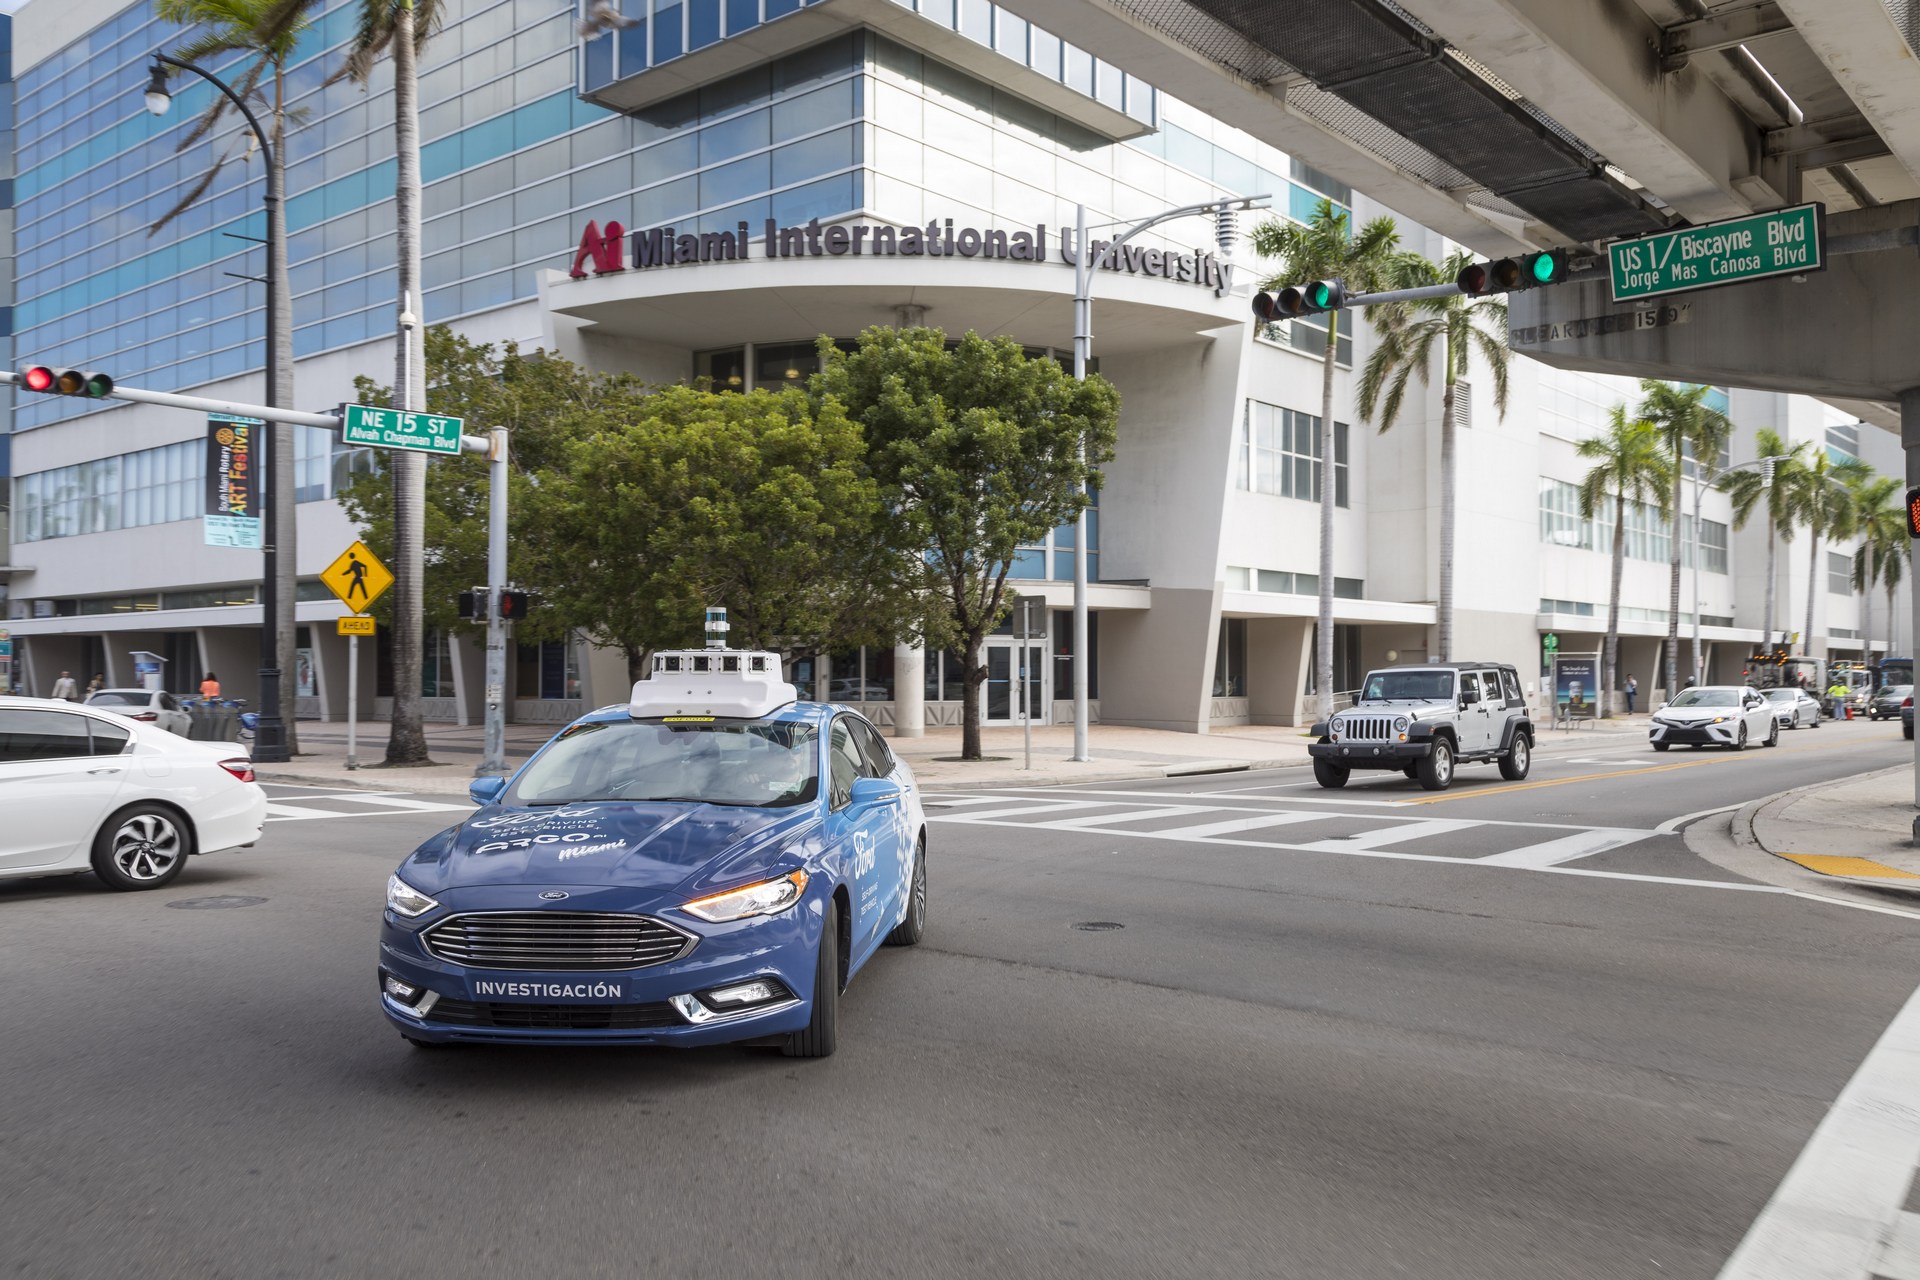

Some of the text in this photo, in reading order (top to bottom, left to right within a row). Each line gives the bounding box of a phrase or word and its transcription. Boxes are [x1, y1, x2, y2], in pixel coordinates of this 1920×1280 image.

[1619, 247, 1642, 272] US
[1680, 230, 1752, 260] Biscayne
[1767, 216, 1805, 246] Blvd
[631, 221, 749, 269] Miami
[765, 217, 1046, 261] International
[1061, 226, 1235, 298] University
[1621, 244, 1807, 290] Jorge Mas Canosa Blvd
[361, 411, 448, 435] NE 15 ST
[349, 426, 456, 449] Alvah Chapman Blvd
[218, 446, 232, 473] Rotary
[228, 423, 249, 479] Festival
[229, 483, 248, 517] ART
[343, 621, 370, 630] AHEAD
[471, 807, 600, 828] Ford
[491, 819, 598, 834] SELF-DRIVING
[490, 823, 595, 839] TEST VEHICLE
[475, 832, 591, 854] ARGO
[558, 838, 627, 861] Miami
[853, 828, 876, 880] Ford
[475, 981, 622, 998] INVESTIGACIÓN
